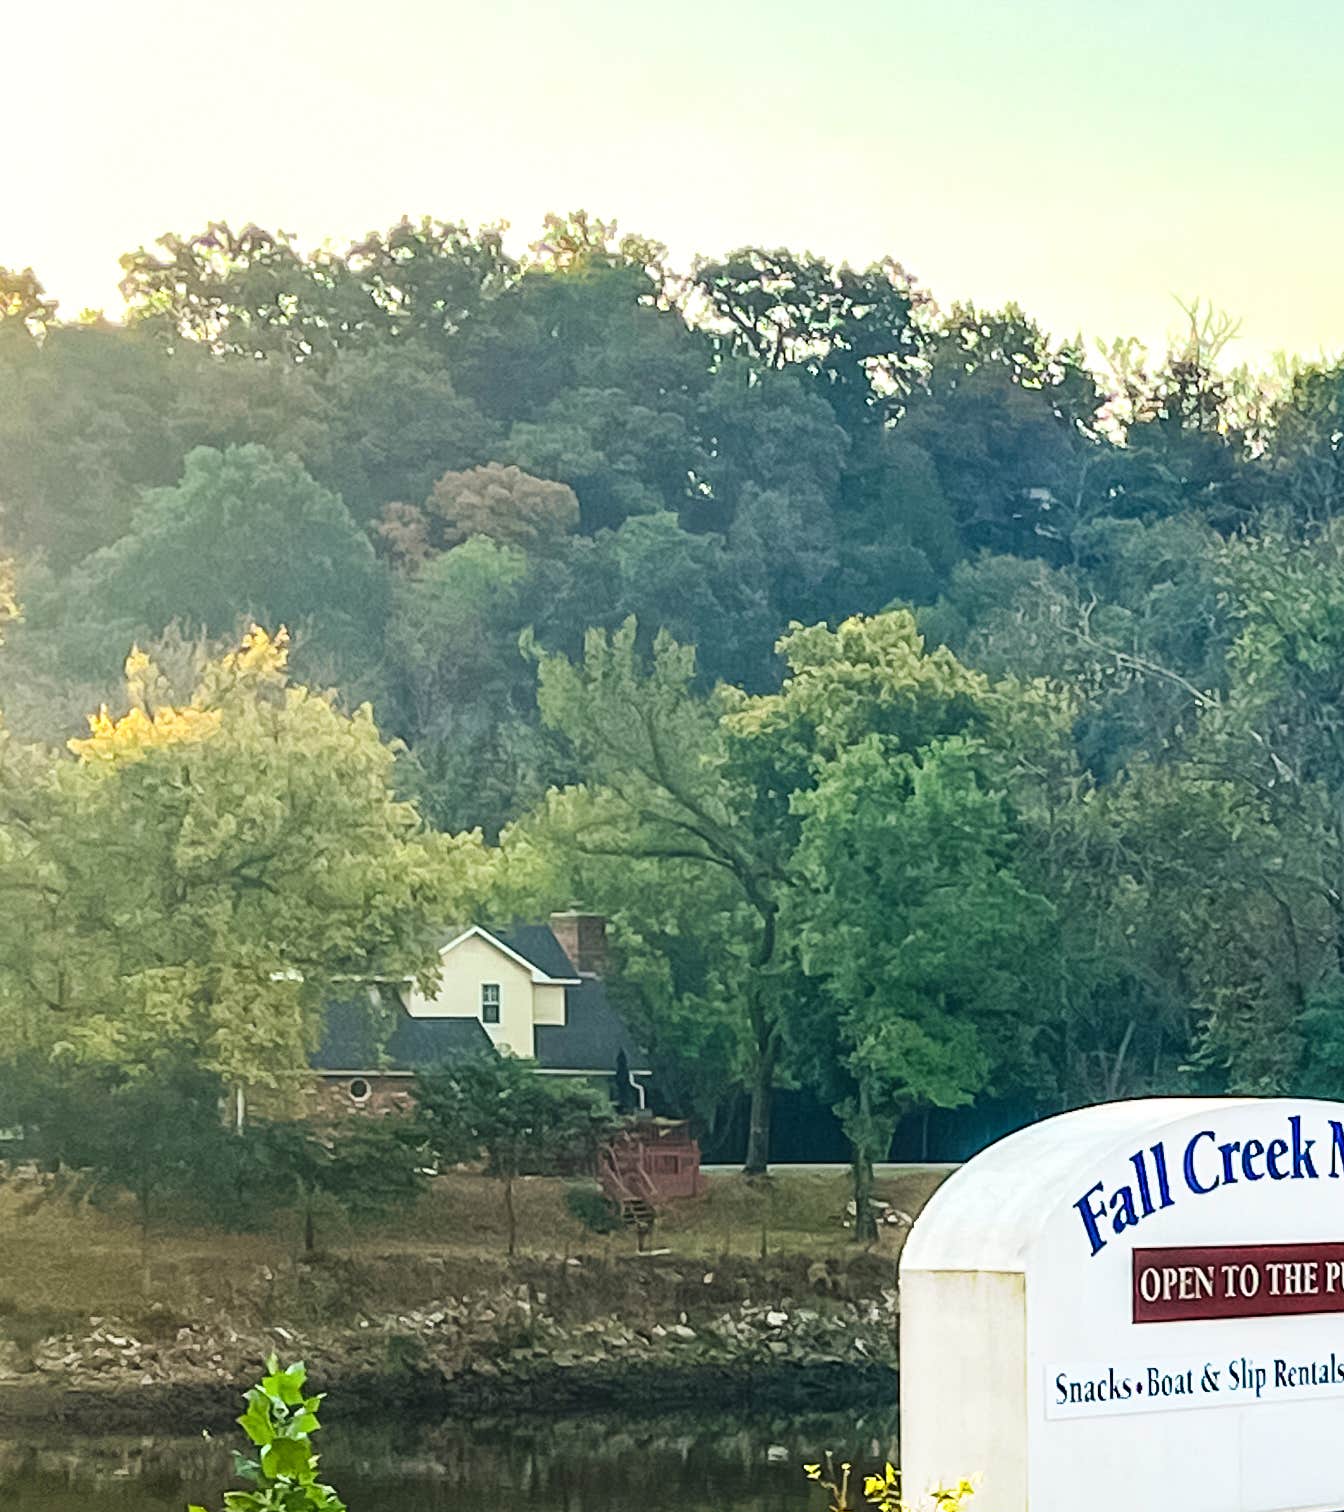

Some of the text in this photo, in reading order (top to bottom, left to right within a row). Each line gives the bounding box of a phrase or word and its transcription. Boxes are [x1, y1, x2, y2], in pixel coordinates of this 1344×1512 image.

[1072, 1141, 1175, 1257] Fall
[1183, 1115, 1319, 1194] Creek
[1140, 1265, 1215, 1302] OPEN
[1221, 1263, 1259, 1298] TO
[1265, 1261, 1319, 1296] THE
[1055, 1367, 1132, 1405] Snacks
[1146, 1367, 1194, 1397] Boat
[1200, 1362, 1221, 1393] &
[1228, 1357, 1266, 1398] Slip
